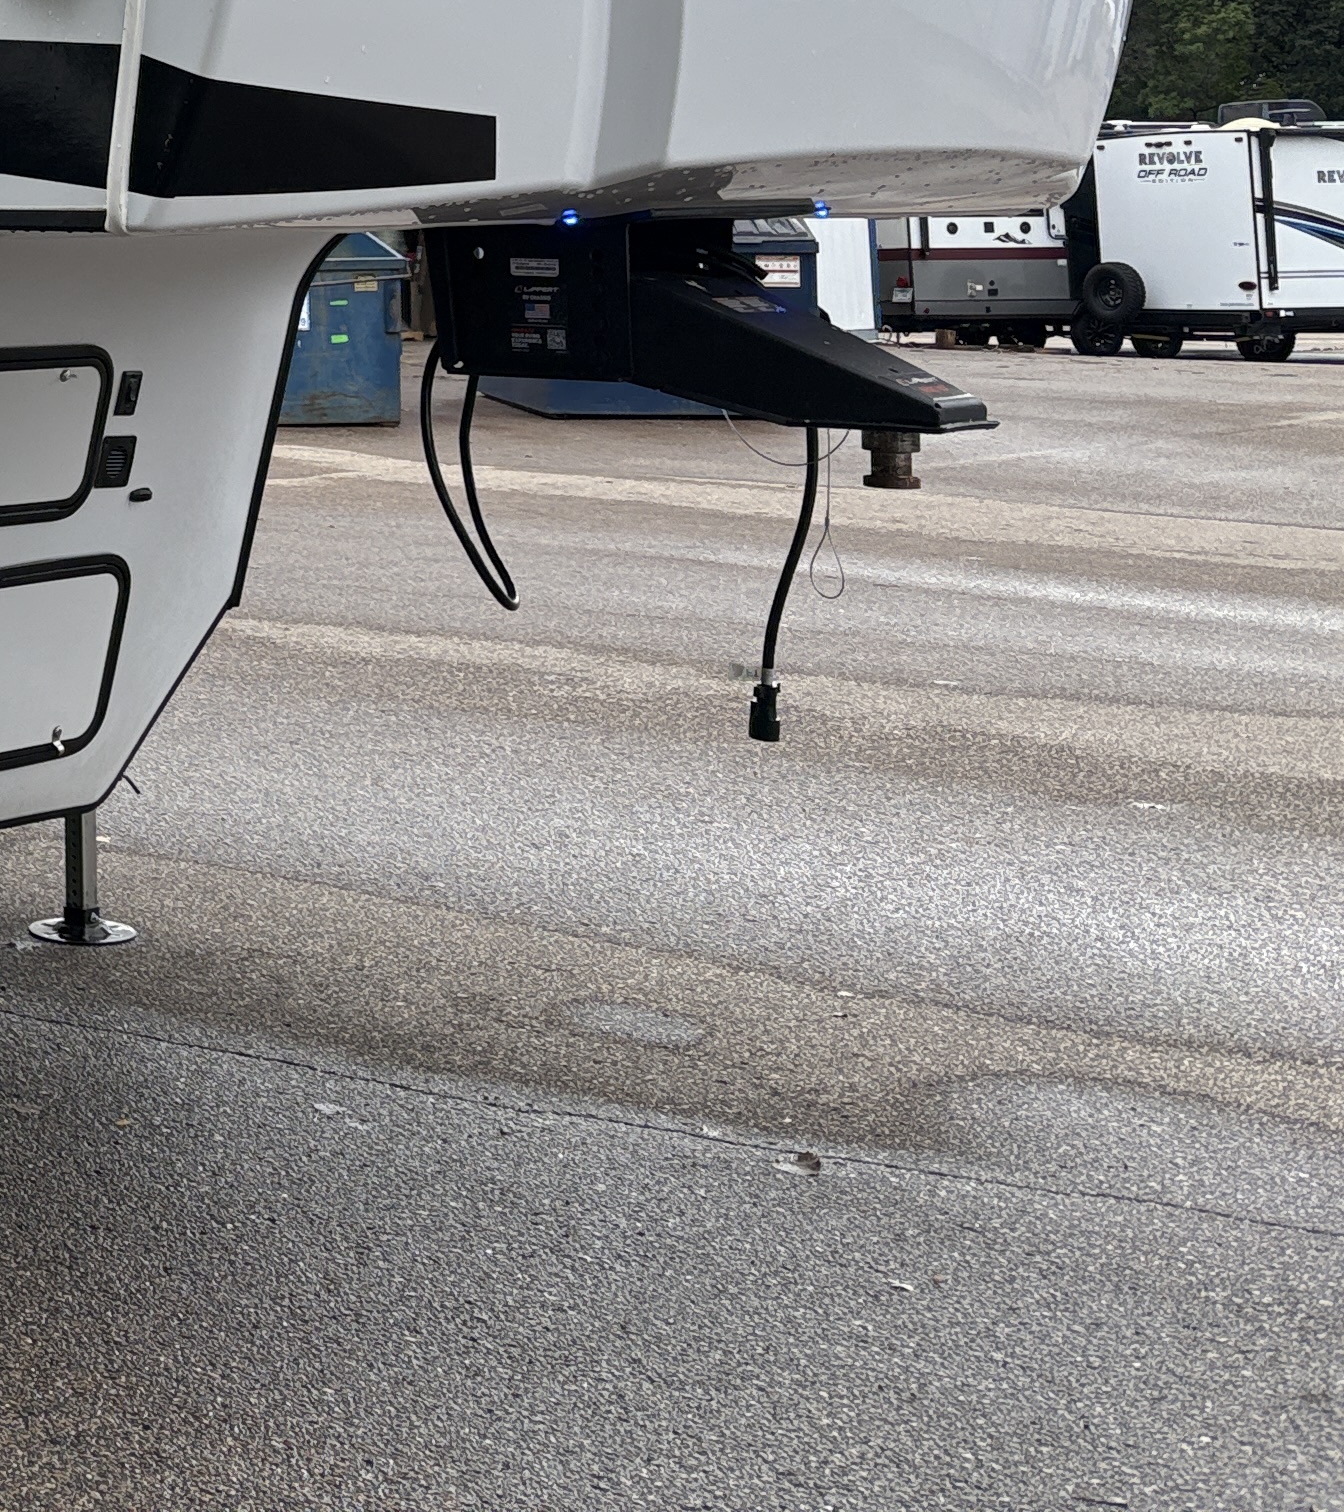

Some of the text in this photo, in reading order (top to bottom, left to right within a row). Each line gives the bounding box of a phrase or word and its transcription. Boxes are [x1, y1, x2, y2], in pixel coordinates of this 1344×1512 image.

[1138, 150, 1203, 166] REVOLVE
[1137, 167, 1208, 179] OFF ROAD
